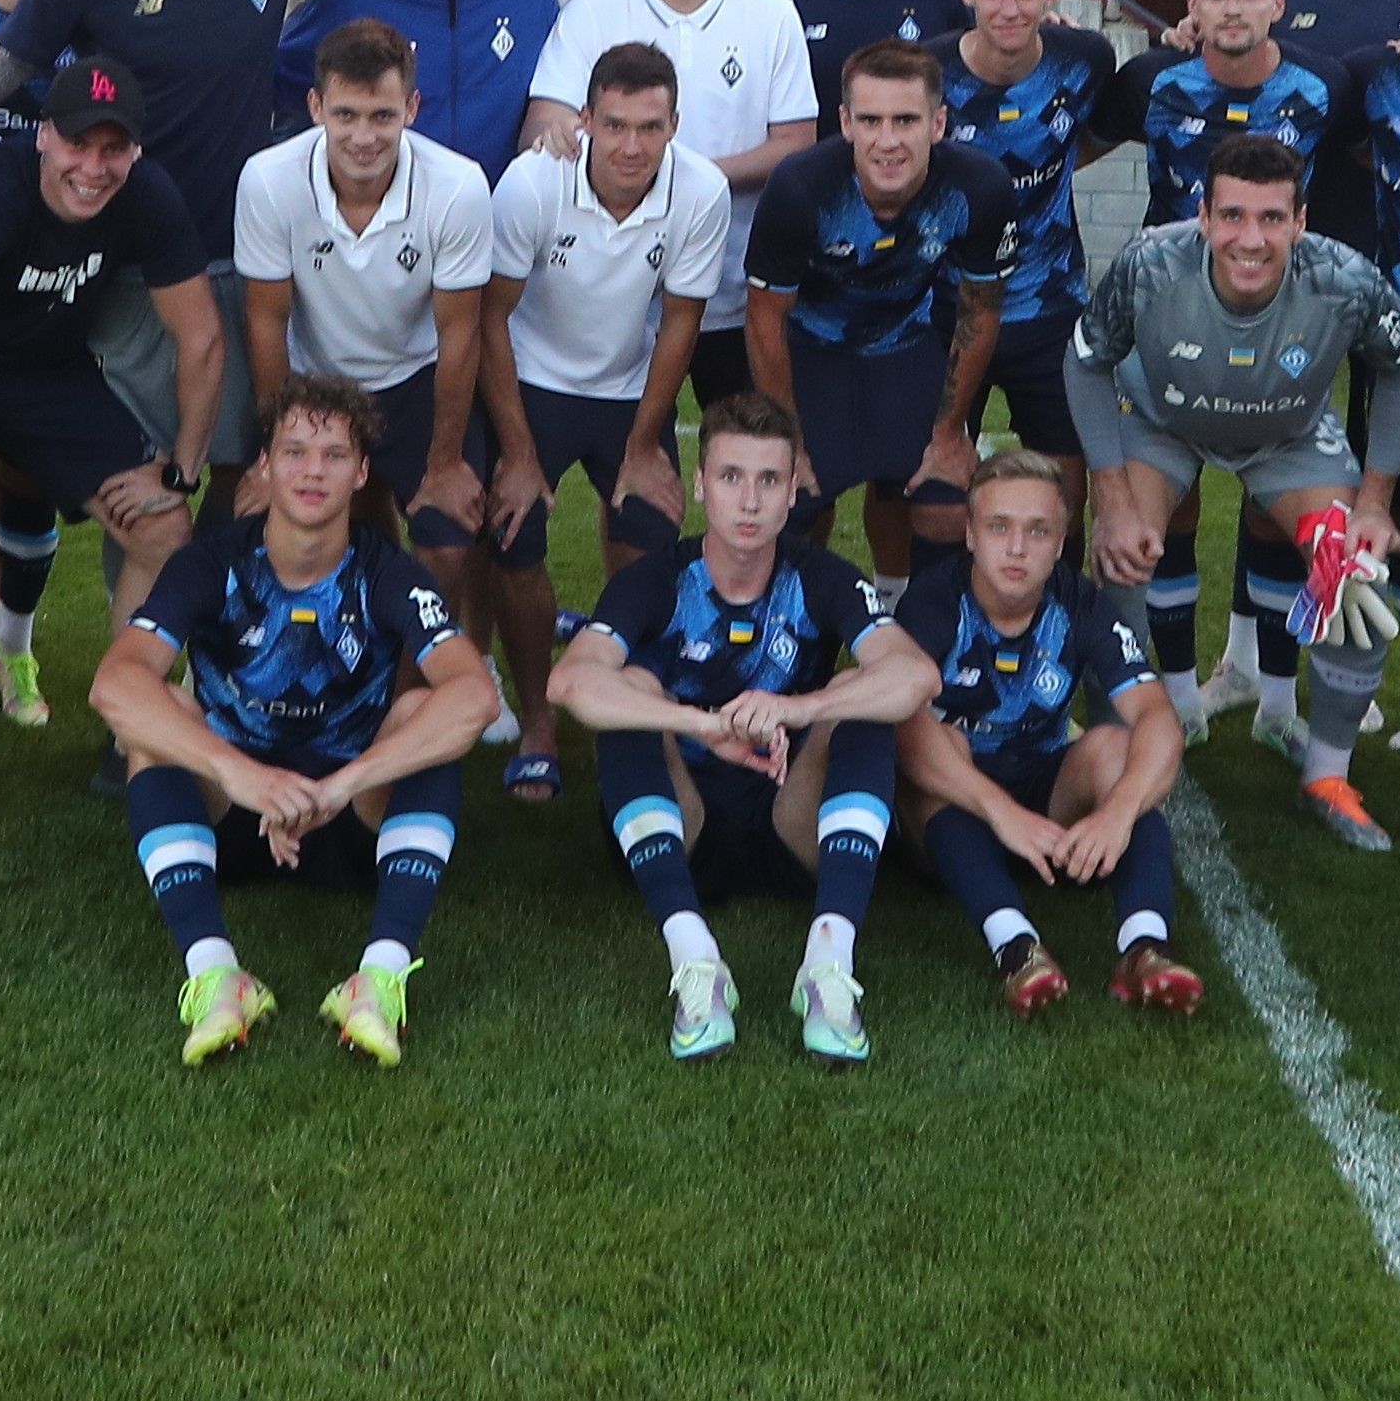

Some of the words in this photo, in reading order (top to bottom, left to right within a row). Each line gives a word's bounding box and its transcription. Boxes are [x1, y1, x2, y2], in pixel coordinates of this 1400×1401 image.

[91, 69, 116, 102] LA
[549, 251, 567, 270] 24
[1192, 394, 1306, 414] ABank24
